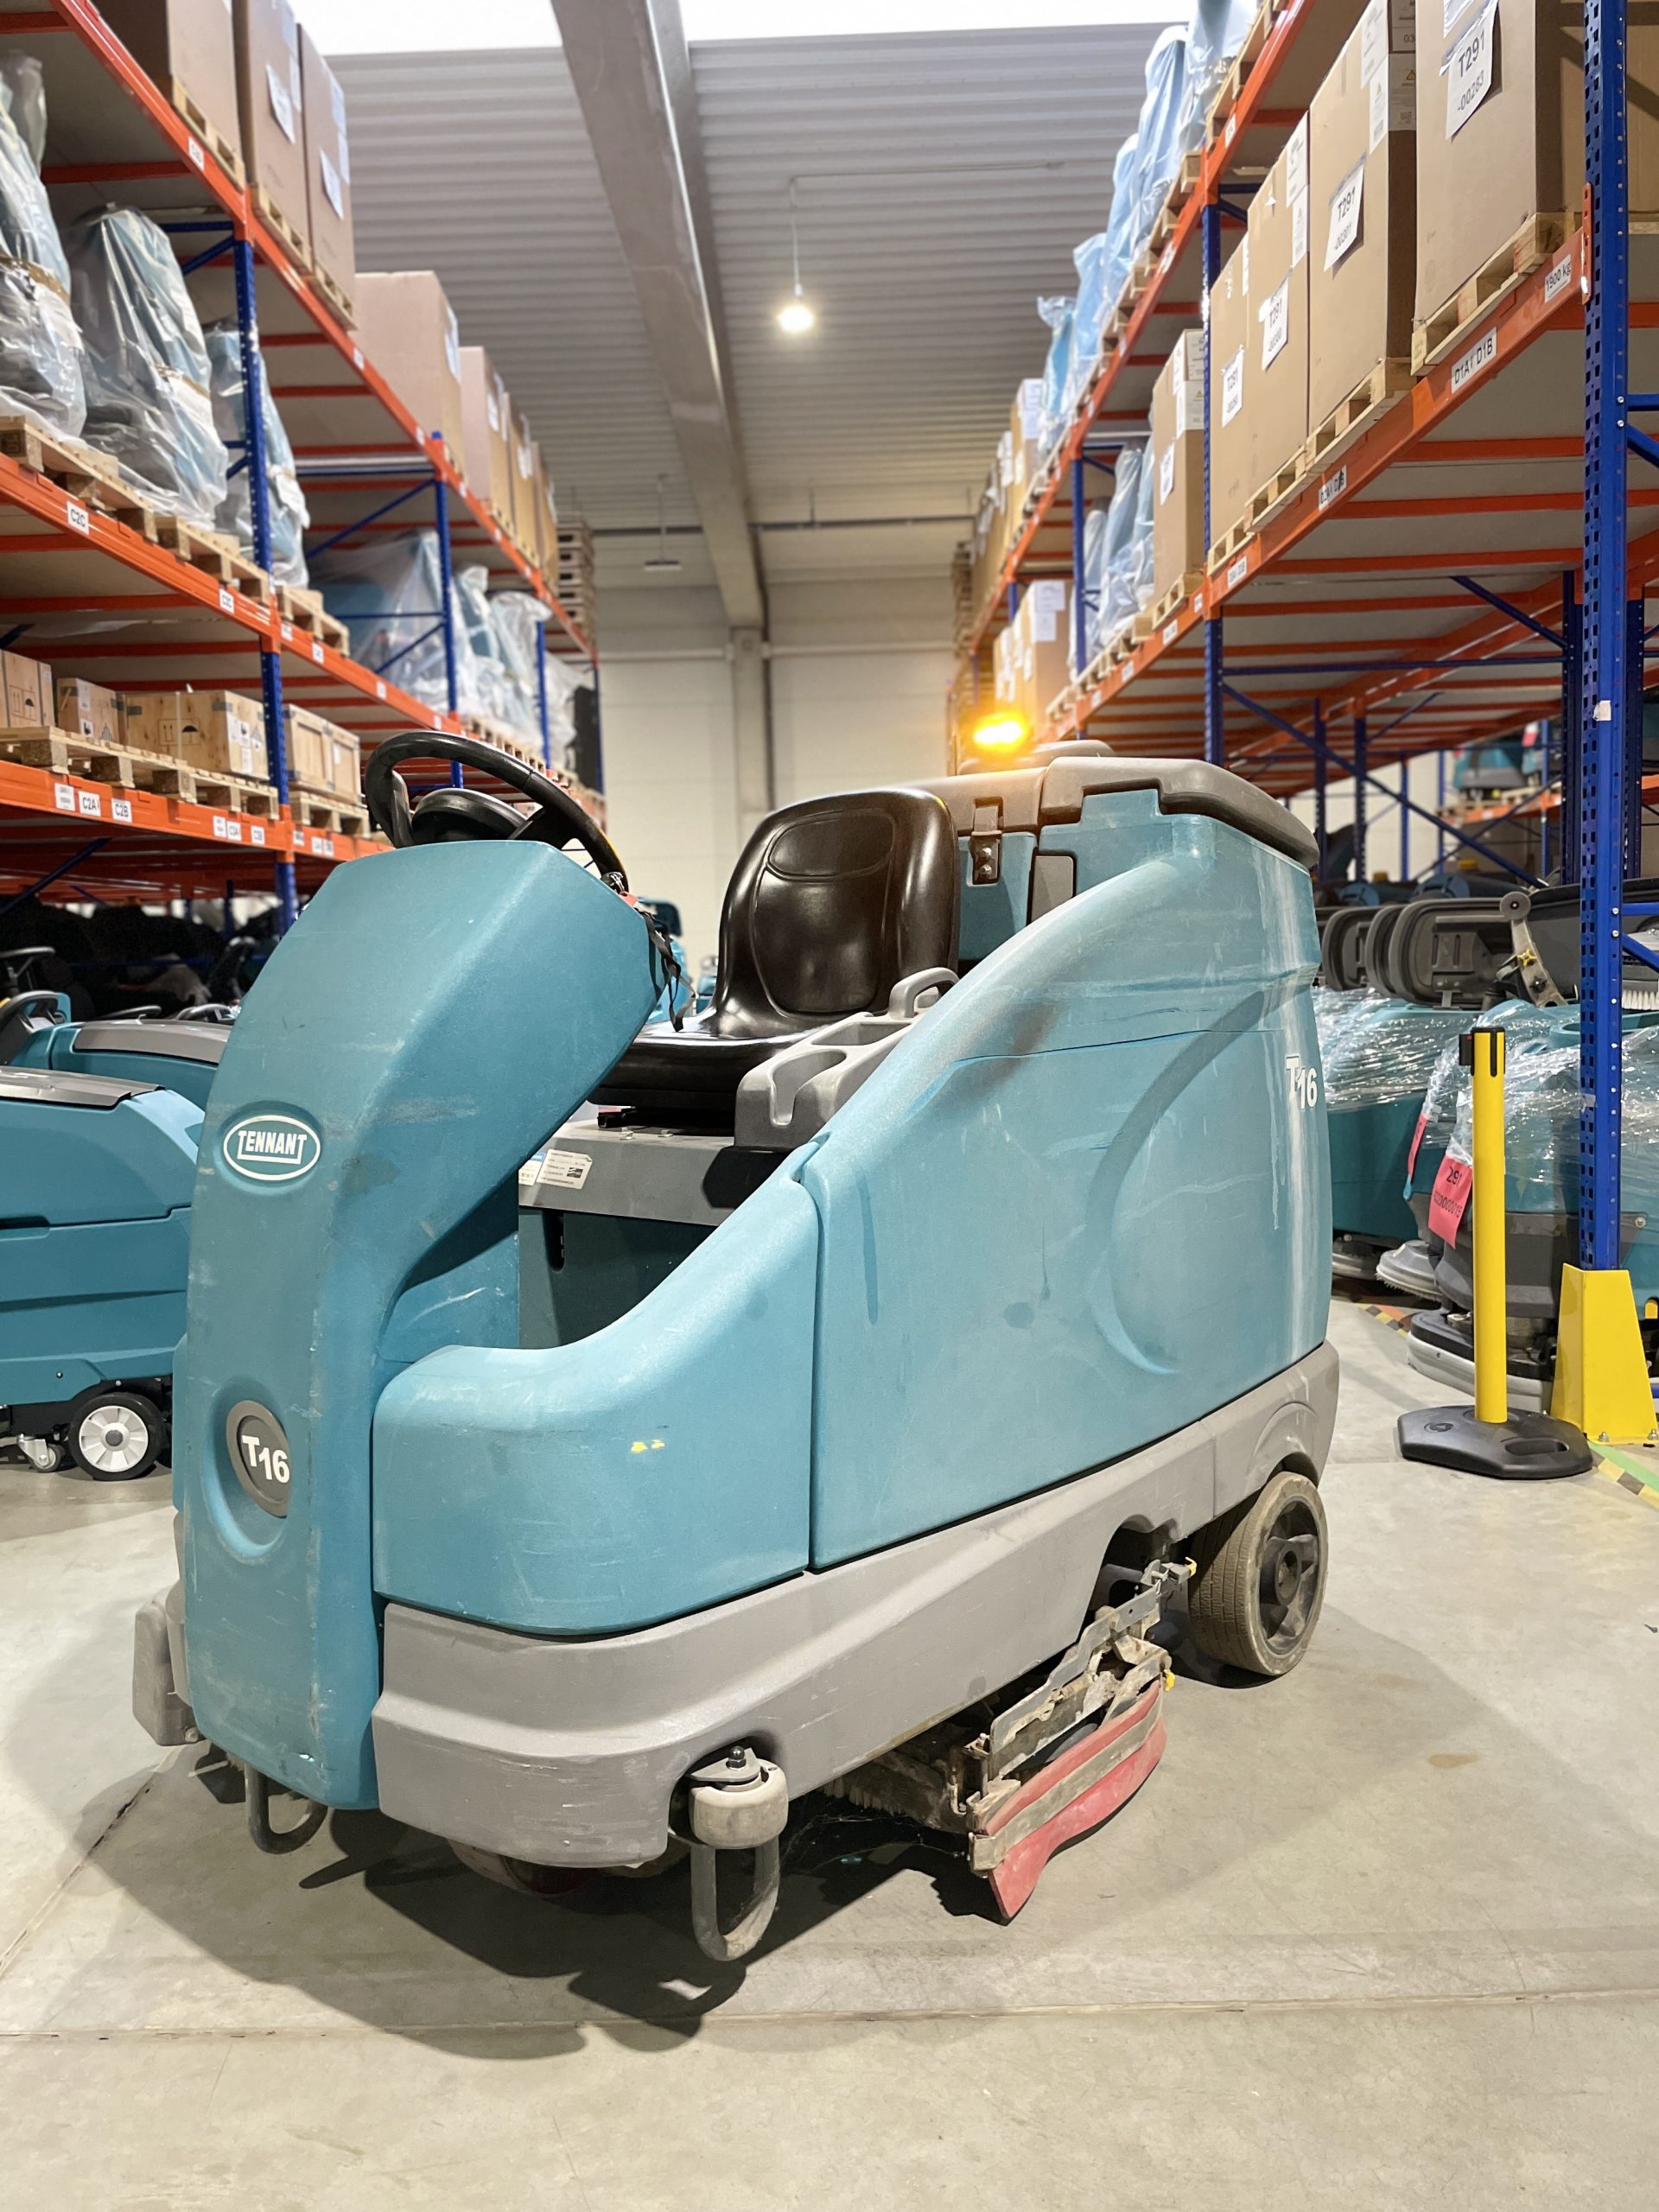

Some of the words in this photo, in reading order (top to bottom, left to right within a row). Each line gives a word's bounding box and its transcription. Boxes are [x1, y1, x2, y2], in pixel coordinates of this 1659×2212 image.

[1458, 28, 1484, 78] T291
[1457, 69, 1485, 112] -00283
[1338, 186, 1356, 222] T291
[1546, 269, 1561, 291] 1900
[1562, 261, 1572, 276] kg
[1454, 359, 1470, 385] D1A
[1476, 337, 1494, 365] D1B
[70, 508, 86, 528] C2C
[82, 797, 97, 810] C2A
[114, 803, 130, 817] C2B
[1285, 1055, 1318, 1109] T16
[238, 1129, 308, 1163] TENNANT
[1446, 1166, 1463, 1186] 291
[241, 1434, 290, 1484] T16
